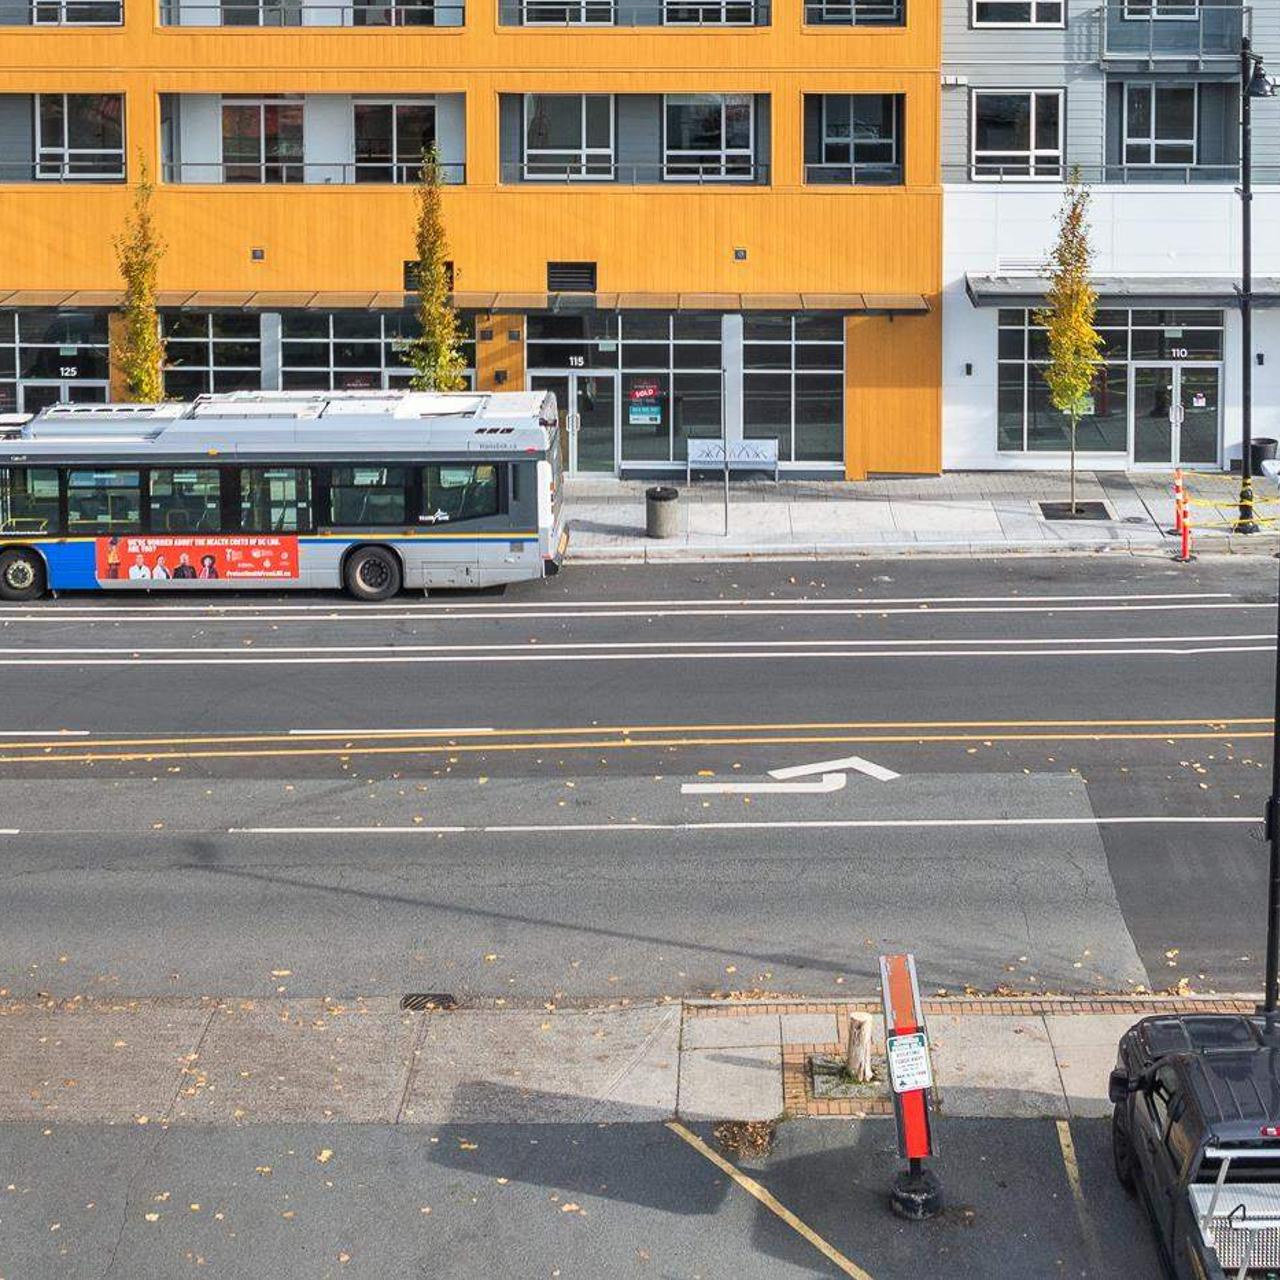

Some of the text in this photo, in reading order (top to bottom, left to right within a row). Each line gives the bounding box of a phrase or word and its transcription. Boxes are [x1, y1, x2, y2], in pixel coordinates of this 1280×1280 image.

[1171, 348, 1188, 358] 110
[569, 356, 585, 367] 115
[59, 367, 78, 377] 125
